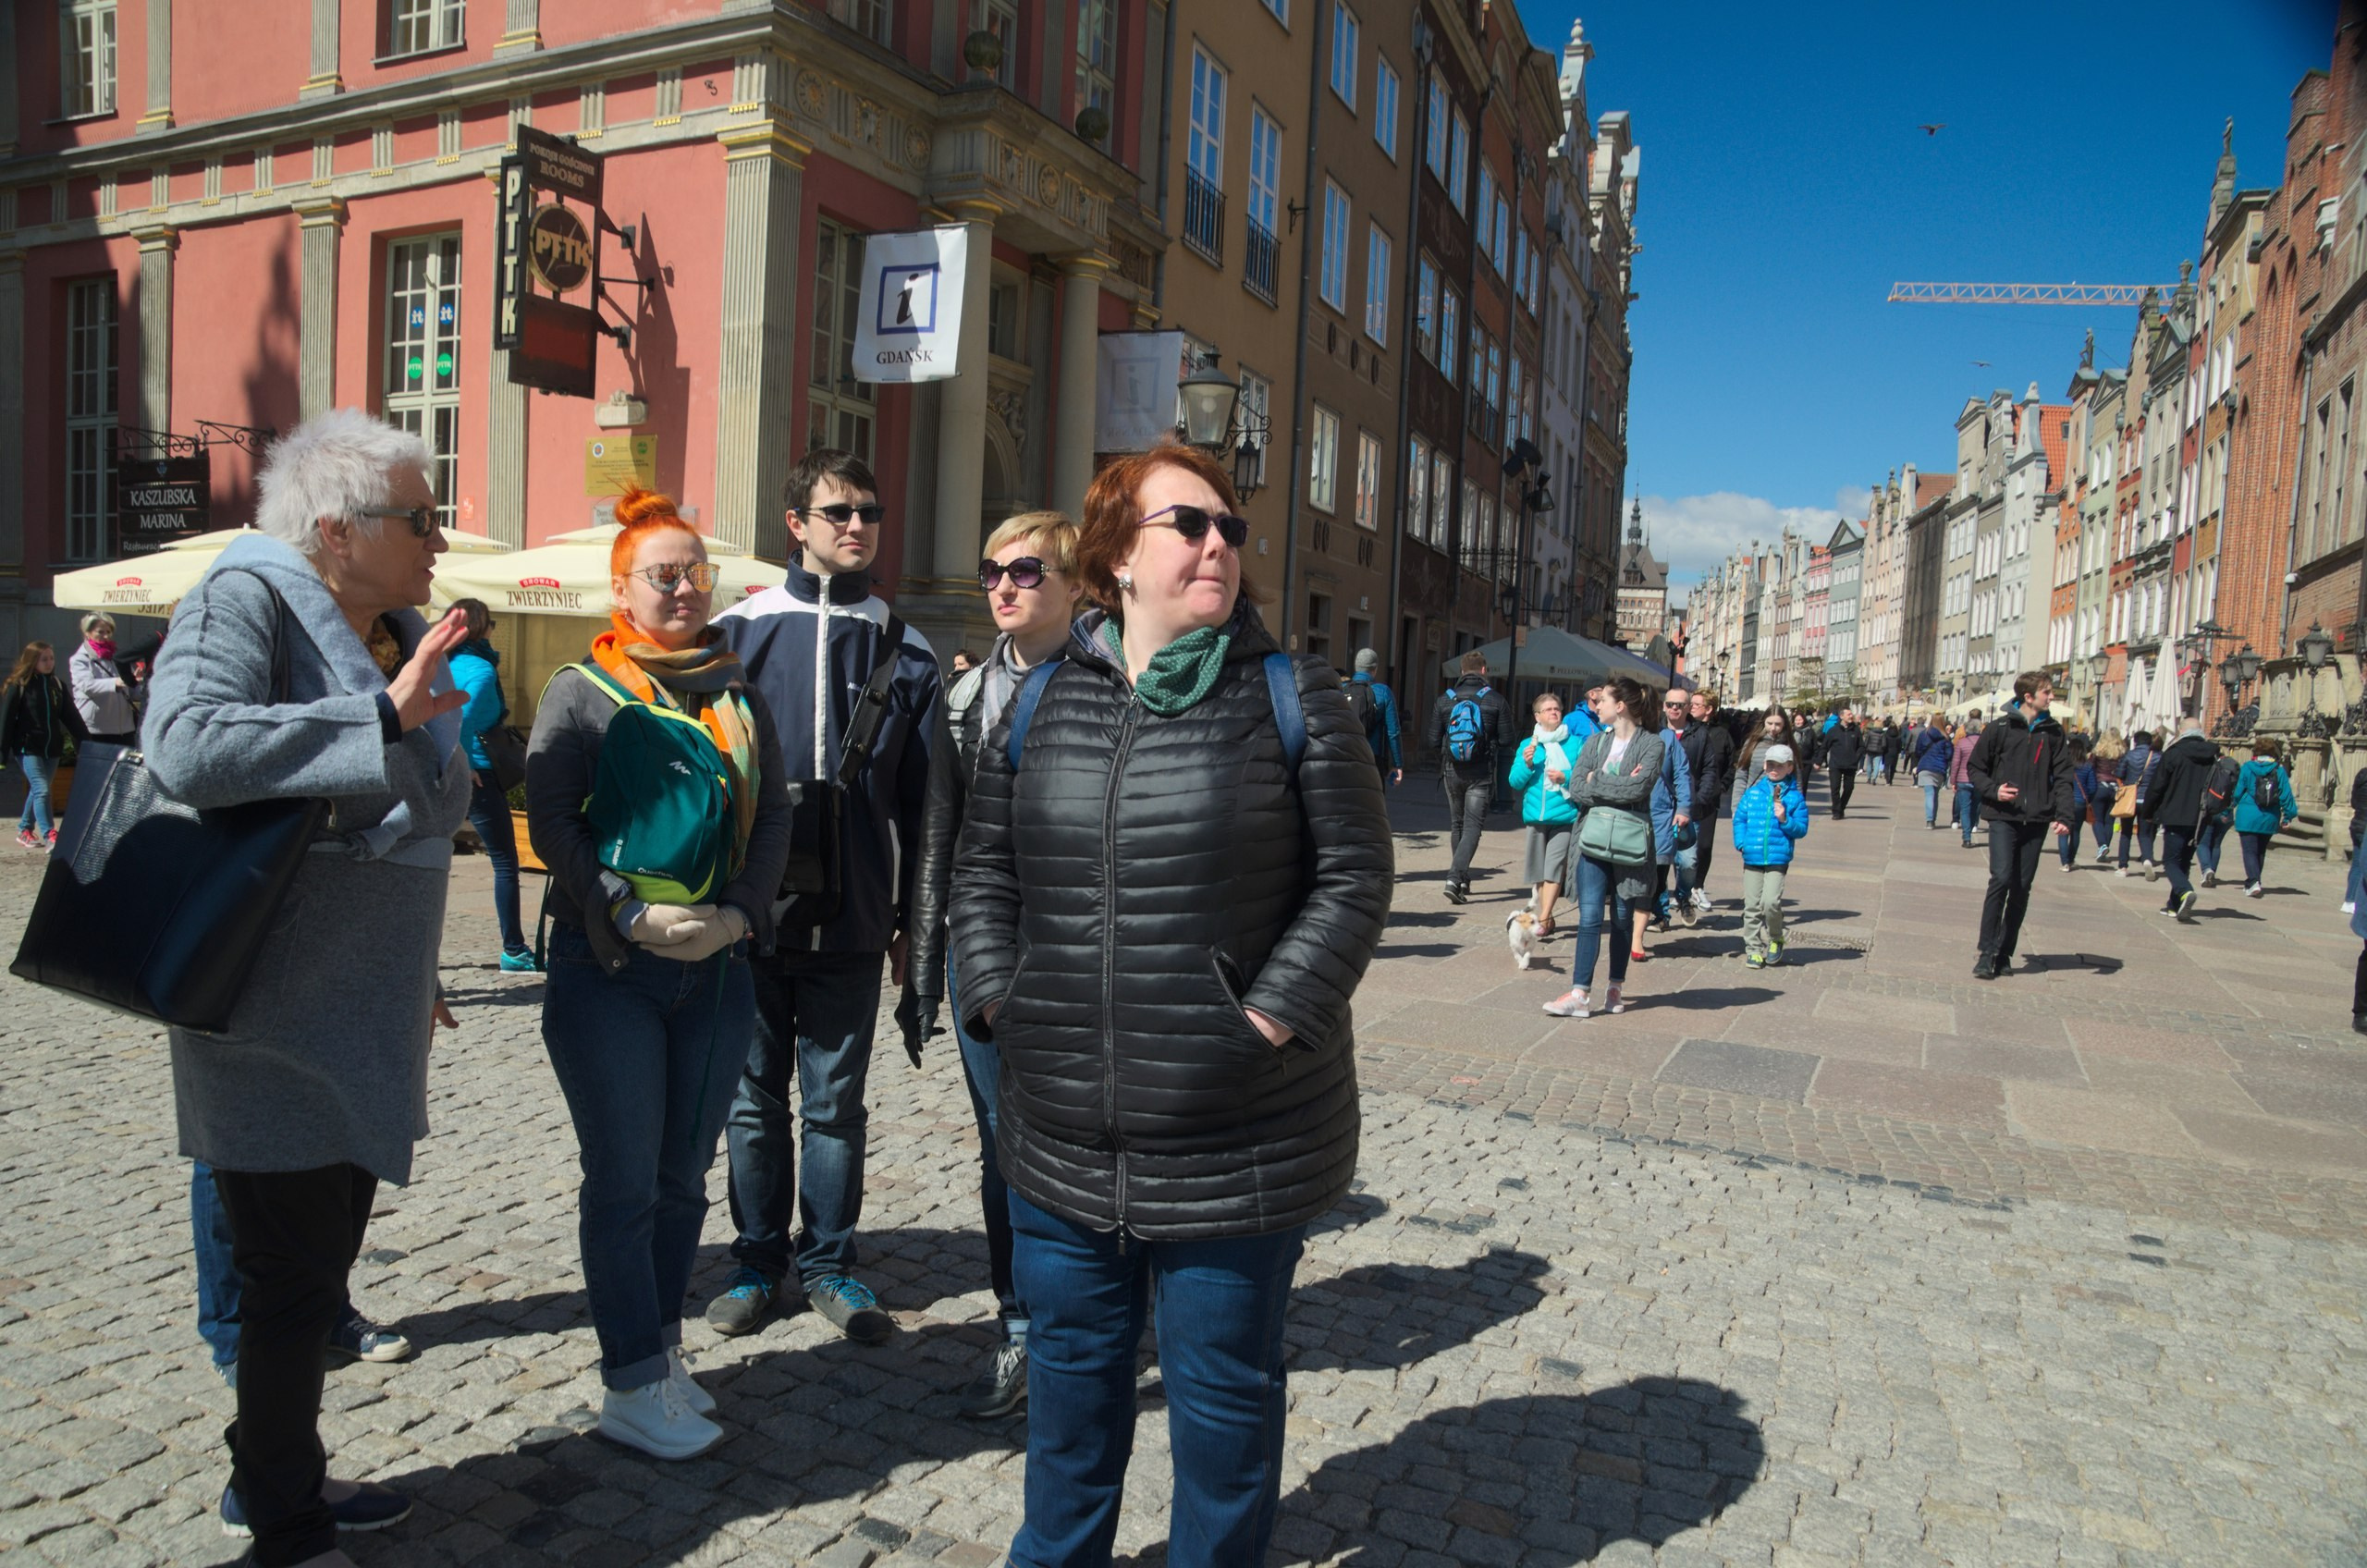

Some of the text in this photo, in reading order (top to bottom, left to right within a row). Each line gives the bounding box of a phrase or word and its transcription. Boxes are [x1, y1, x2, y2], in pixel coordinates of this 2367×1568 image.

[540, 160, 584, 188] ROOMS
[501, 169, 521, 335] PTTK
[440, 306, 453, 321] it
[877, 347, 934, 364] GDAŃSK
[130, 488, 196, 507] KASZUBSKA
[140, 513, 187, 529] MARINA
[123, 540, 161, 554] Restauracj
[522, 578, 557, 587] BROWAR
[103, 589, 152, 603] ZWIERZYNIEC
[507, 591, 582, 609] ZWIERZYNIEC
